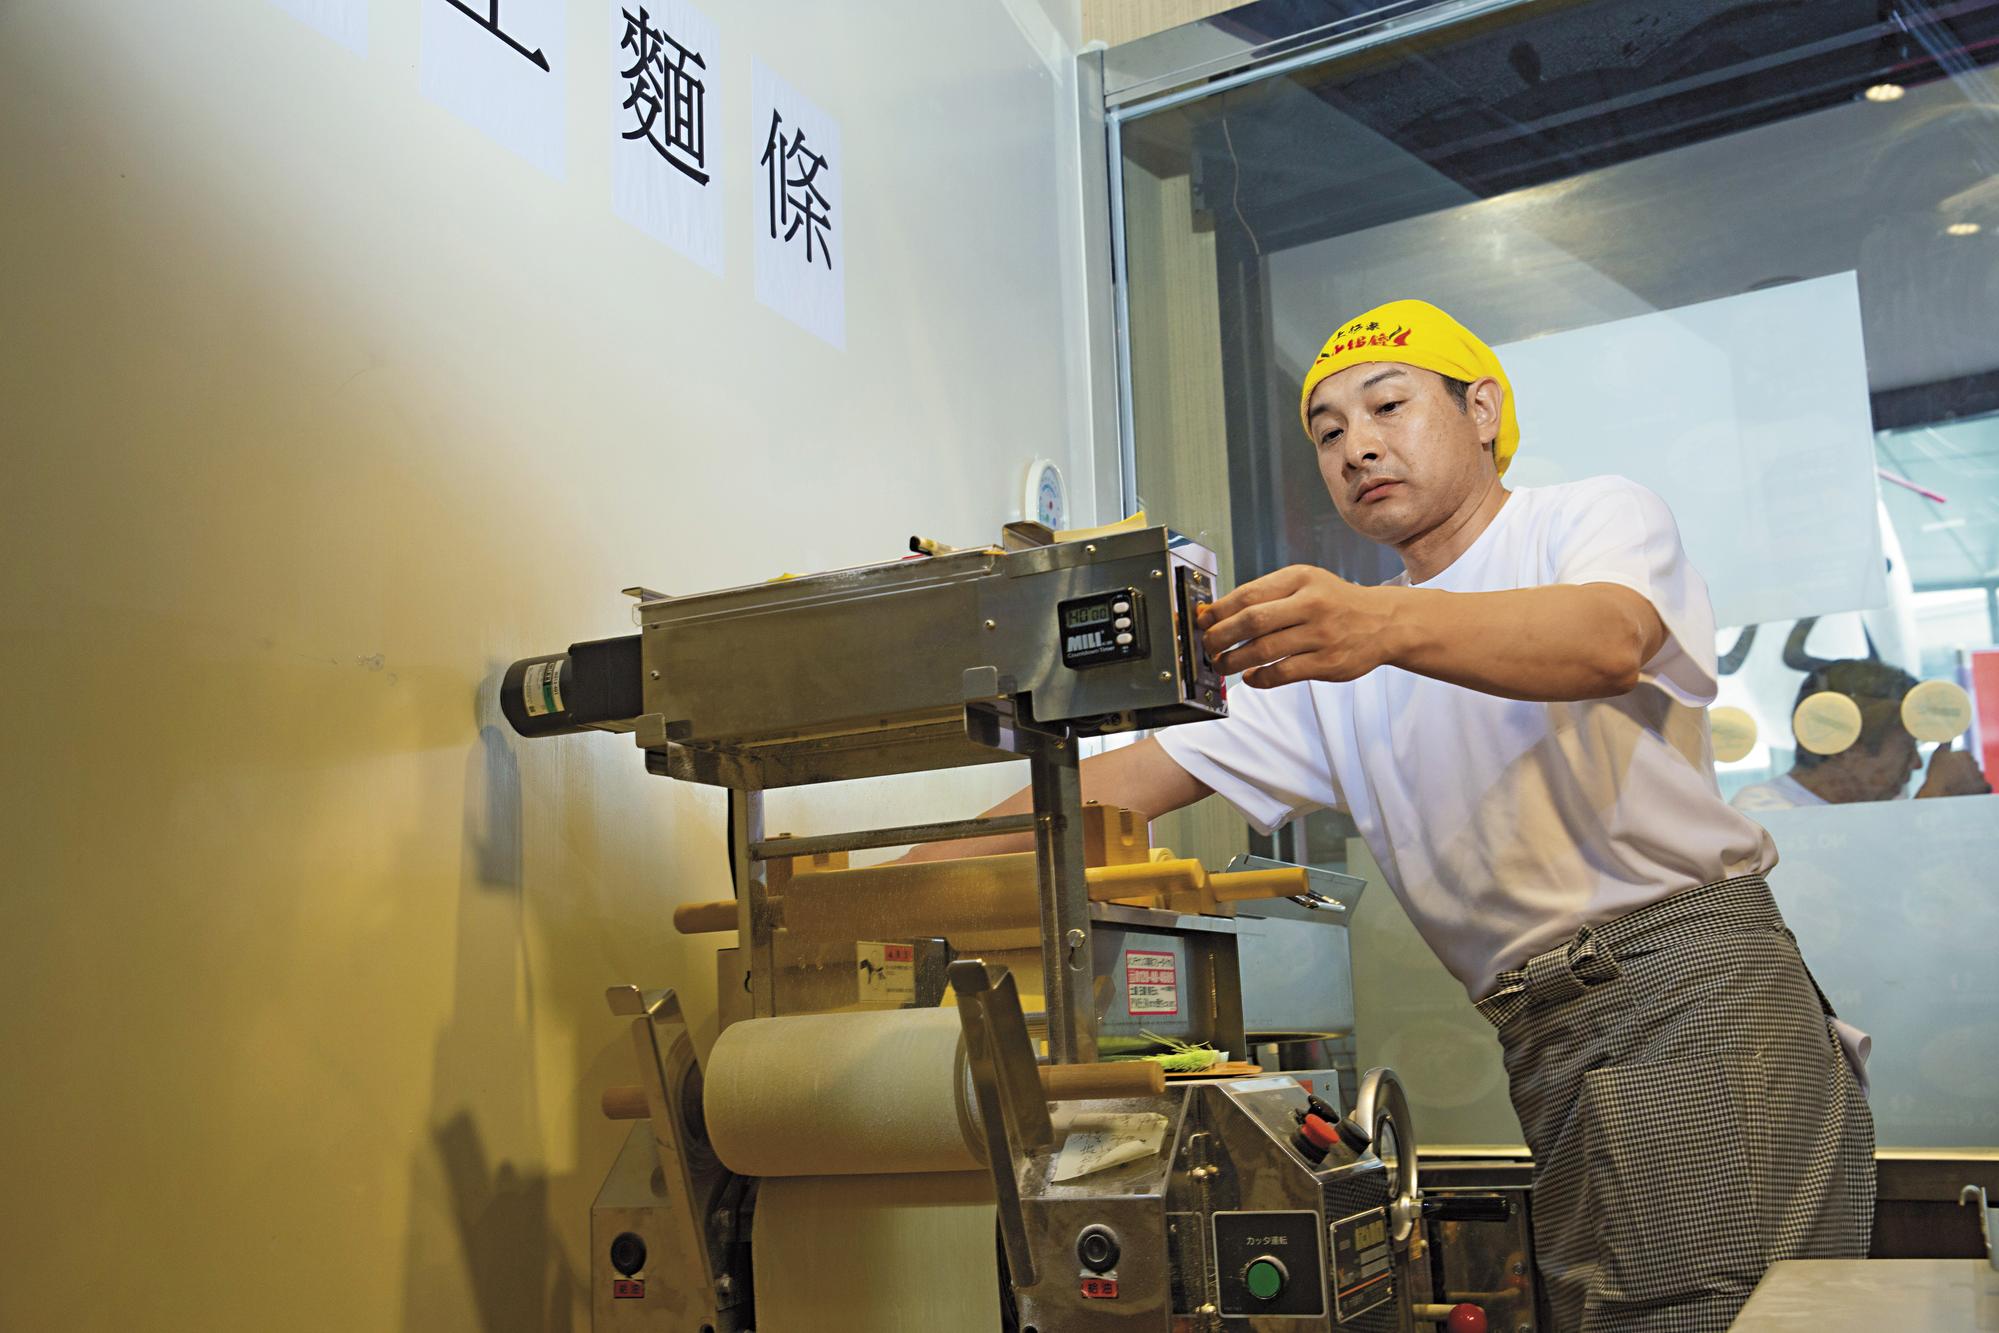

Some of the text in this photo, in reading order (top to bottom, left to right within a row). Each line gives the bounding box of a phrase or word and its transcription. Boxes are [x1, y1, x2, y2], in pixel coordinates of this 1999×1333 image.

[1099, 645, 1115, 653] Timer
[1246, 1236, 1288, 1246] カッタ運転
